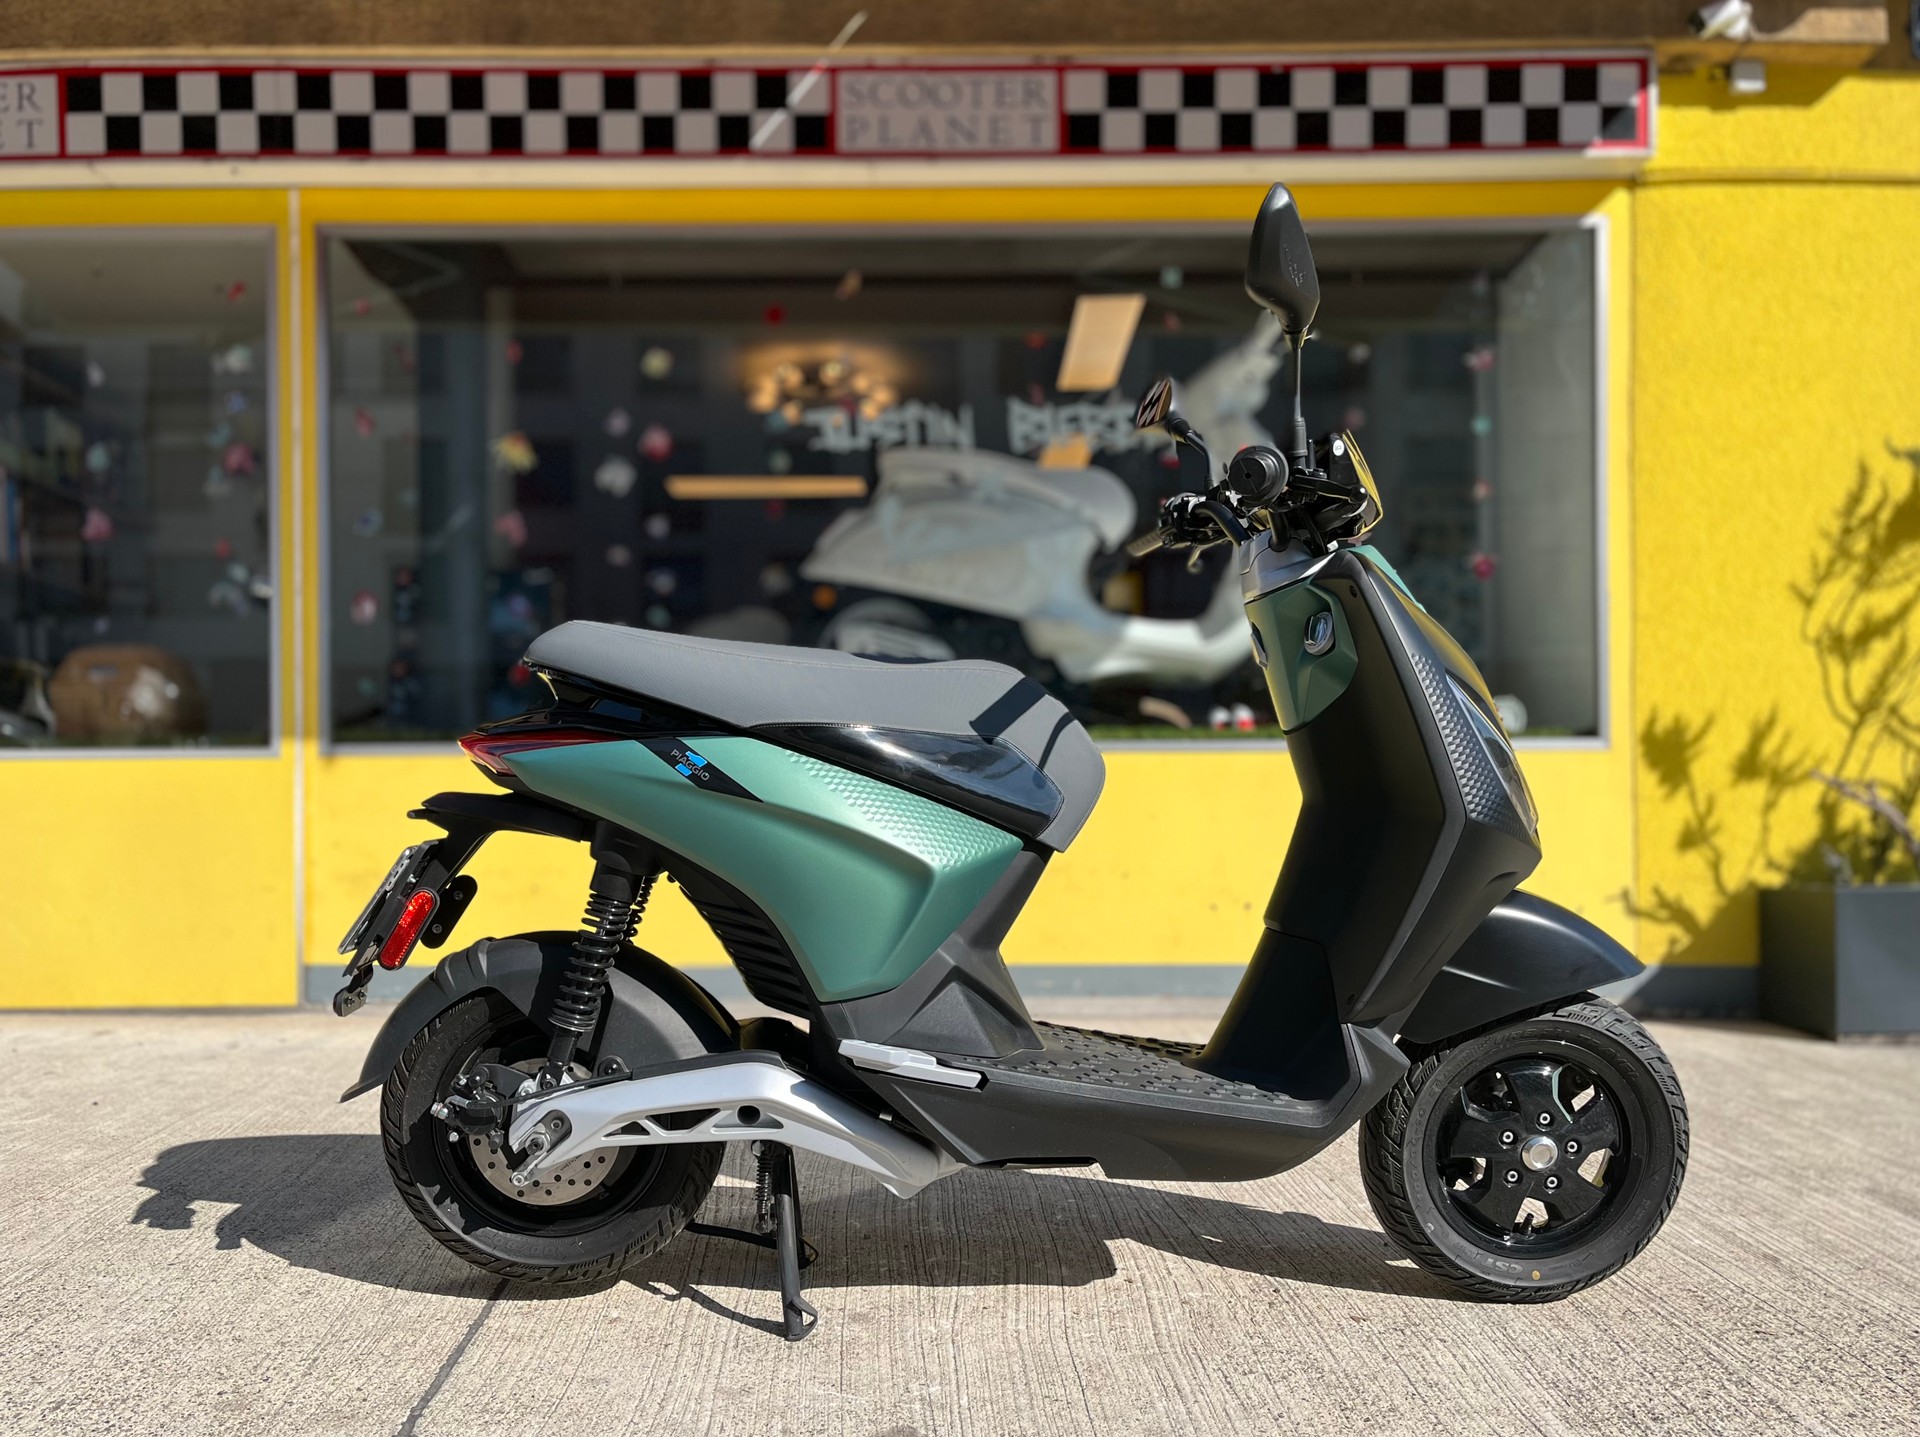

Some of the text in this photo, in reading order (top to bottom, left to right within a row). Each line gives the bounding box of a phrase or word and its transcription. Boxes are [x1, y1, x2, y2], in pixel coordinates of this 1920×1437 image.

[844, 76, 1048, 112] SCOOTER
[844, 114, 1048, 147] PLANET
[670, 748, 710, 781] PIAGGIO
